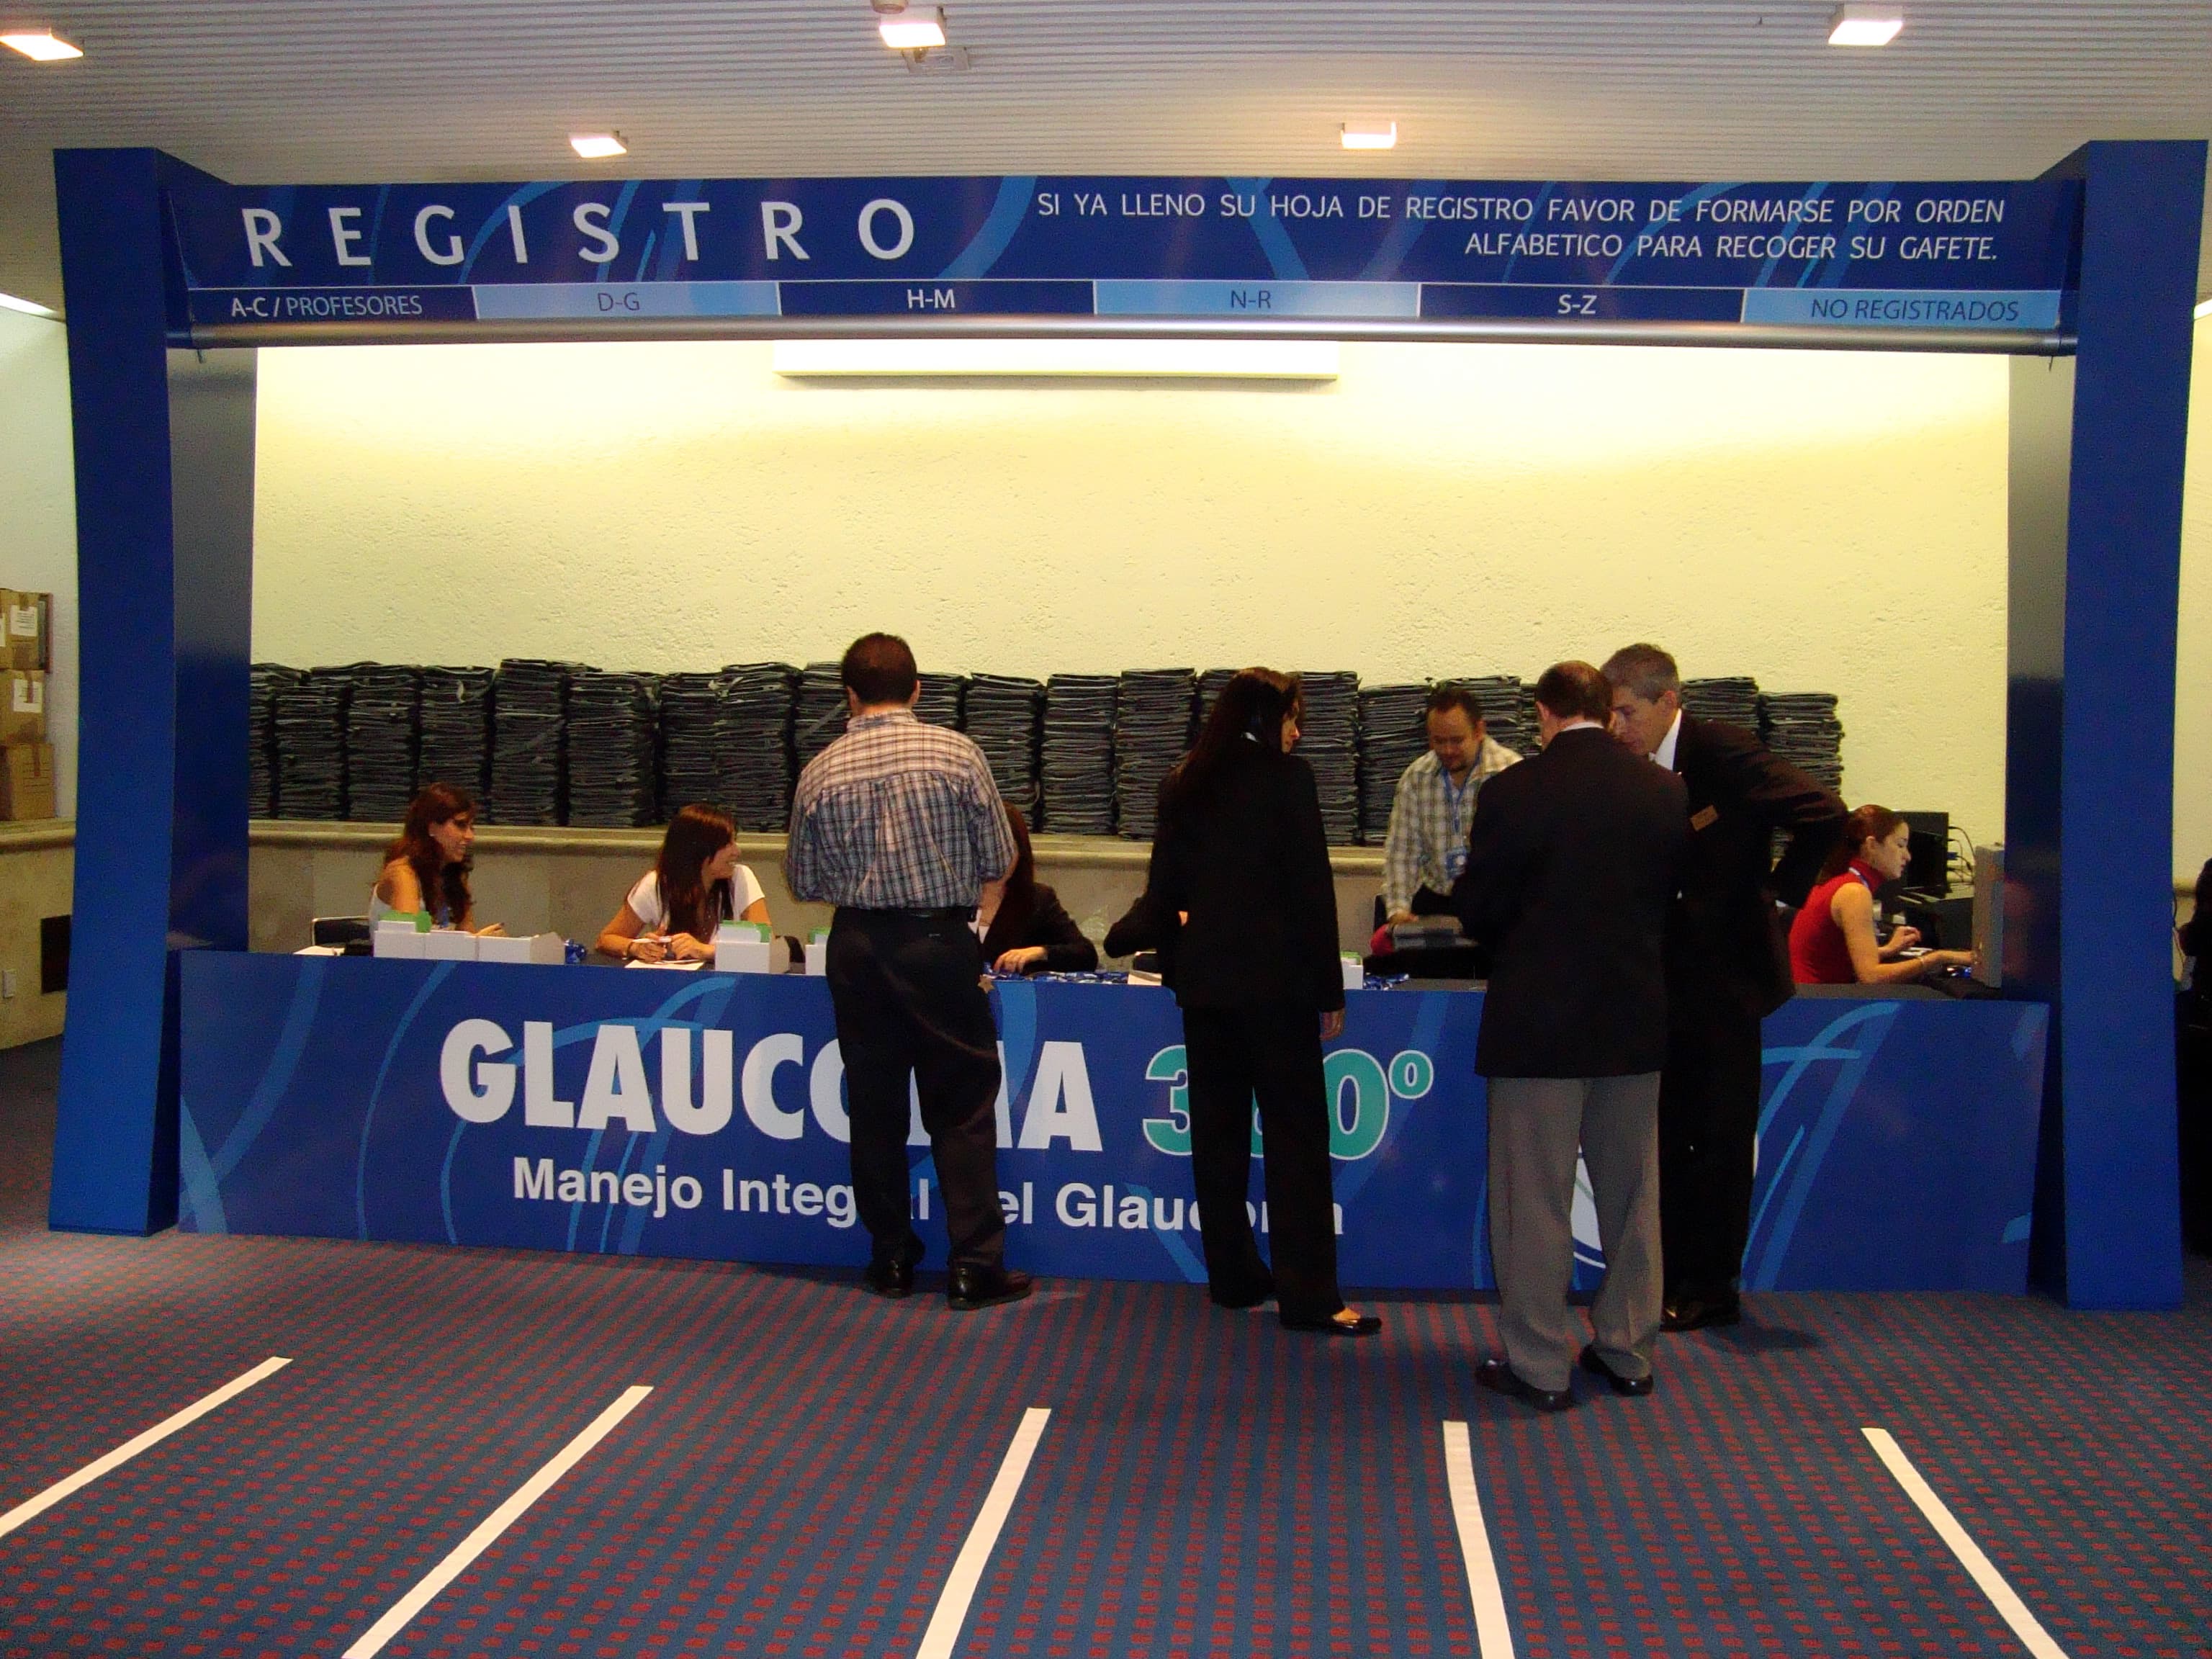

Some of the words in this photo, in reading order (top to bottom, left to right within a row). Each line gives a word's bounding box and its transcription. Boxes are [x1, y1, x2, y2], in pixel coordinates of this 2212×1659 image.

[1038, 192, 1059, 216] SI
[1074, 193, 1107, 216] YA
[1122, 193, 1205, 217] LLENO
[1220, 194, 1256, 217] SU
[1271, 194, 1344, 218] HOJA
[1358, 196, 1391, 218] DE
[1406, 196, 1534, 221] REGISTRO
[1547, 199, 1635, 222] FAVOR
[1649, 199, 1683, 222] DE
[1696, 199, 1835, 222] FORMARSE
[1847, 199, 1902, 223] POR
[1915, 199, 2005, 223] ORDEN
[241, 198, 914, 266] REGISTRO
[1465, 233, 1623, 257] ALFABETICO
[1637, 234, 1702, 258] PARA
[1717, 234, 1836, 258] RECOGER
[1849, 235, 1887, 259] SU
[1899, 235, 1997, 260] GAFETE.
[231, 297, 268, 318] A-C
[285, 295, 423, 316] PROFESORES
[597, 292, 640, 312] D-G
[907, 288, 956, 309] H-M
[1230, 289, 1272, 309] N-R
[1557, 294, 1598, 315] S-Z
[1811, 298, 1848, 319] NO
[1855, 299, 2019, 322] REGISTRADOS
[513, 1156, 703, 1218] Manejo
[723, 1169, 929, 1228] Integl
